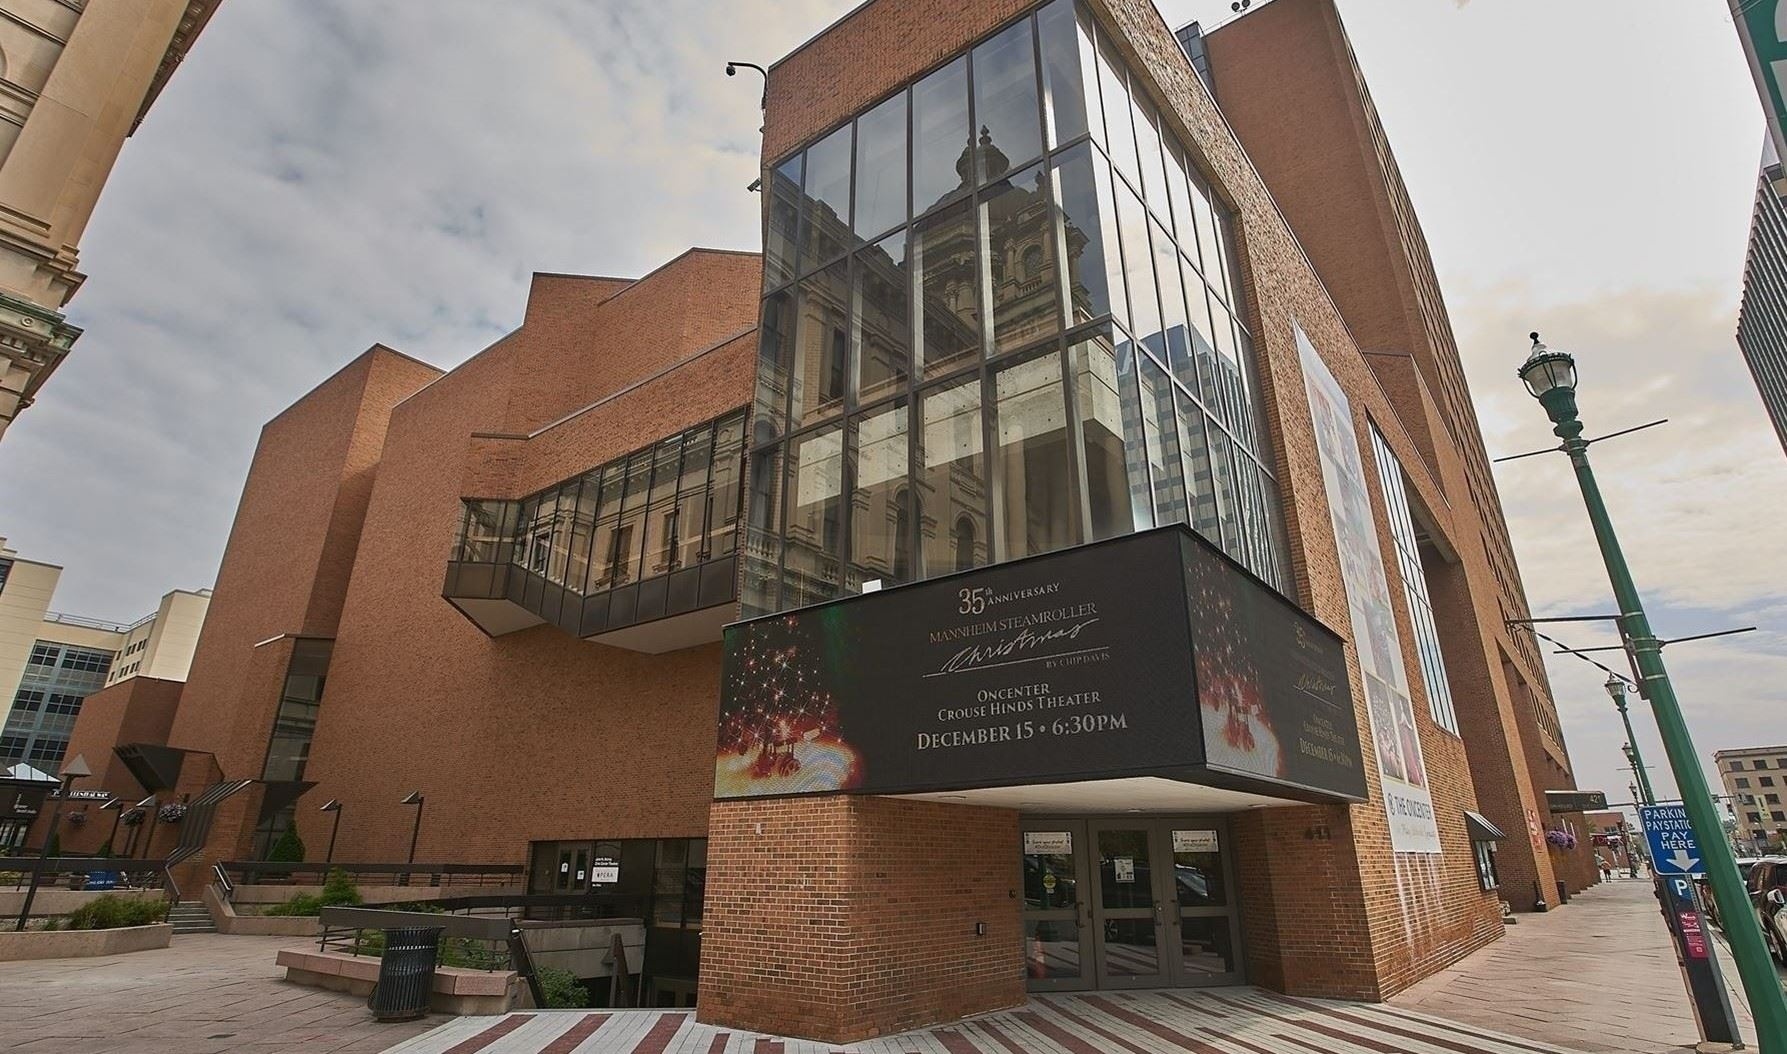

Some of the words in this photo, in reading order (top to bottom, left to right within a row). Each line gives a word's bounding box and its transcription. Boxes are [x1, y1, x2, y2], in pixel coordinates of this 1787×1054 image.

[988, 582, 1060, 605] ANNIVERSARY
[929, 621, 997, 644] MANNHEIM
[999, 601, 1097, 631] STEAMROLLER
[940, 618, 1099, 672] Christmas
[1016, 721, 1034, 740] 15
[1052, 713, 1128, 736] 6:30PM
[1644, 808, 1687, 819] PARKIN
[1646, 820, 1692, 831] PAYSTATI
[1661, 831, 1688, 841] PAY
[1660, 840, 1696, 850] HERE
[1675, 879, 1688, 896] P
